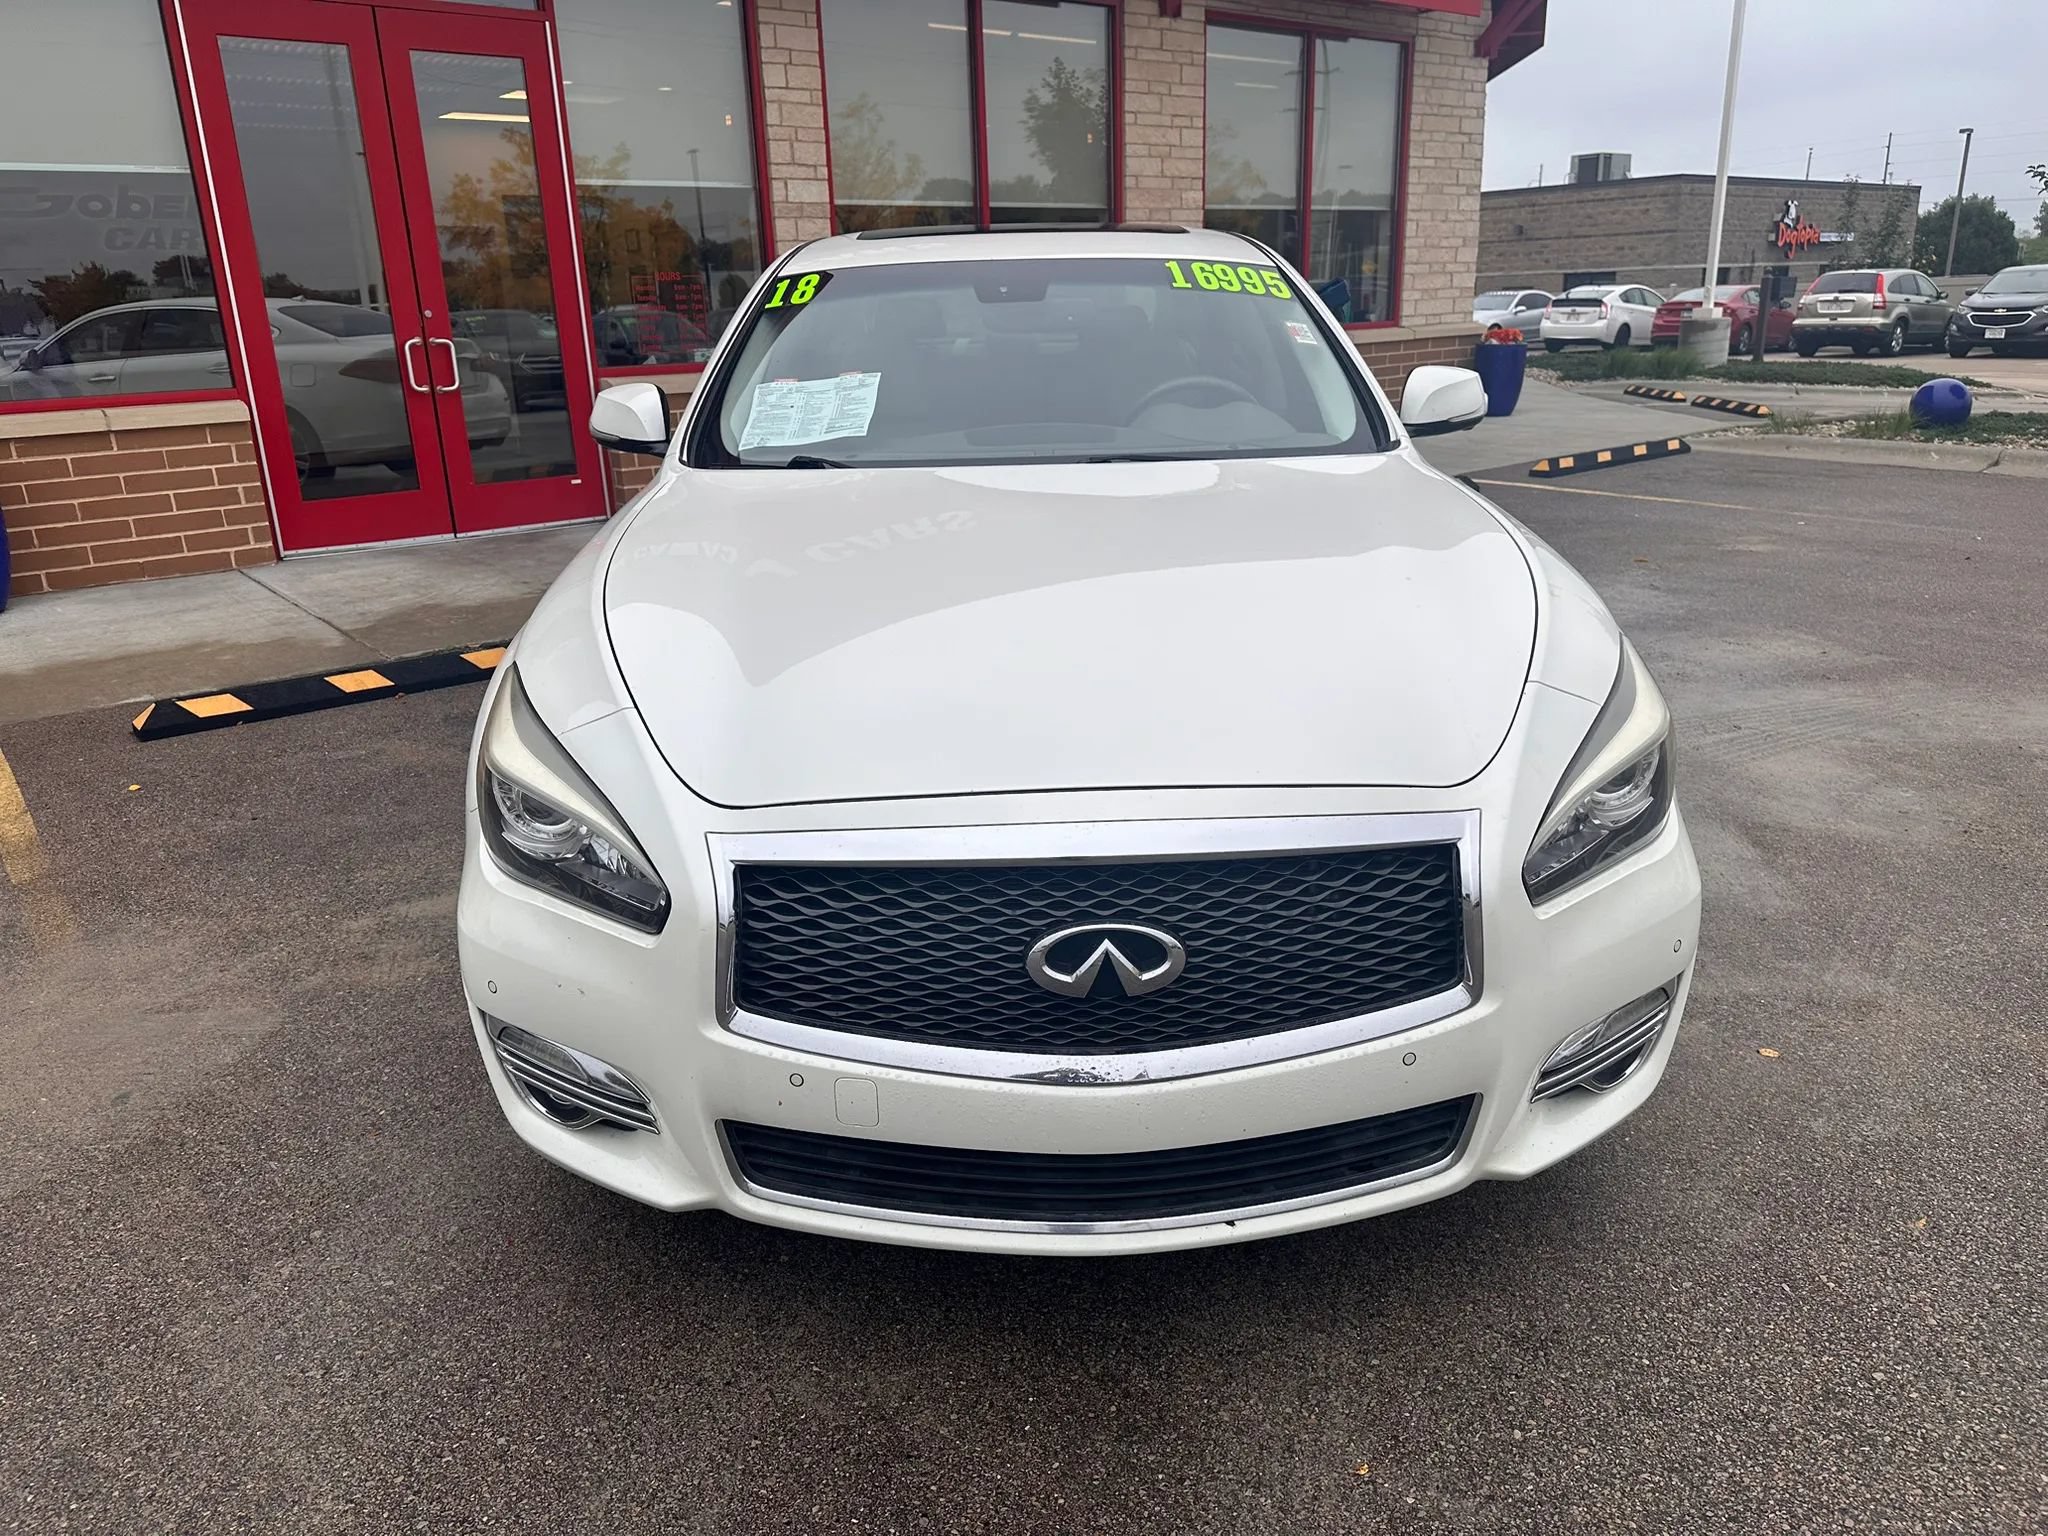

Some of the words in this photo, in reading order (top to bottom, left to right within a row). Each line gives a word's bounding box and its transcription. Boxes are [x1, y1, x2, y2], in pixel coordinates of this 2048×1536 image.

[1777, 213, 1820, 259] Dogtopia
[764, 273, 821, 309] 18
[1164, 260, 1292, 299] 16995
